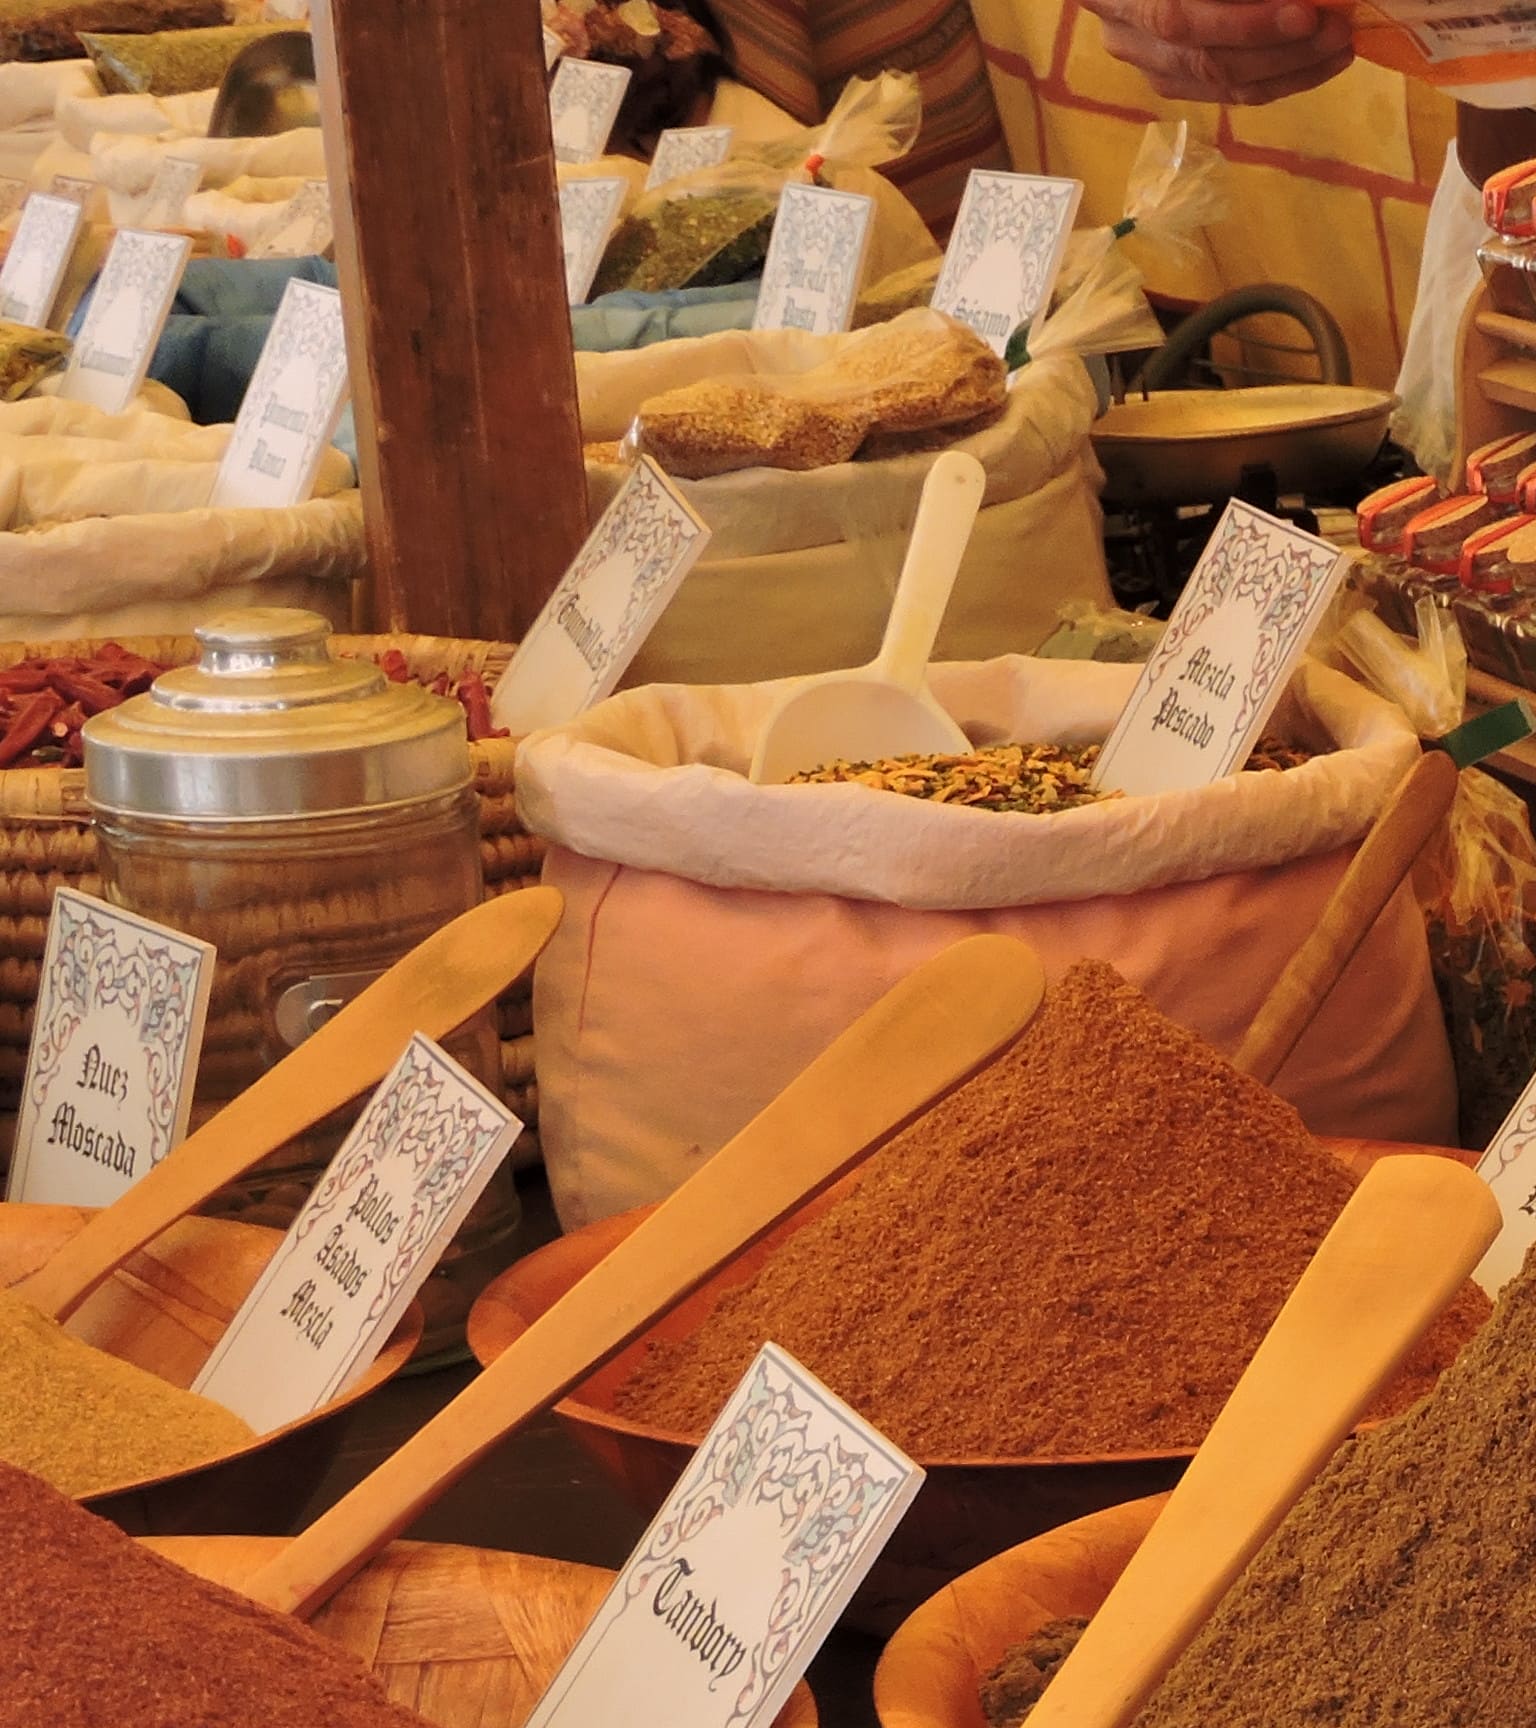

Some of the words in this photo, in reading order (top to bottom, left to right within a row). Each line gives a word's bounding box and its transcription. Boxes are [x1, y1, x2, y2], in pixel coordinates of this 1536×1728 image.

[1178, 646, 1236, 701] Mezcla
[1152, 687, 1215, 750] Pescado
[76, 1044, 129, 1110] Nuez
[47, 1101, 137, 1179] Moscada
[345, 1173, 400, 1245] Pollos
[314, 1223, 369, 1299] Asados
[280, 1278, 334, 1351] Mezcla
[651, 1557, 748, 1693] Tandory
